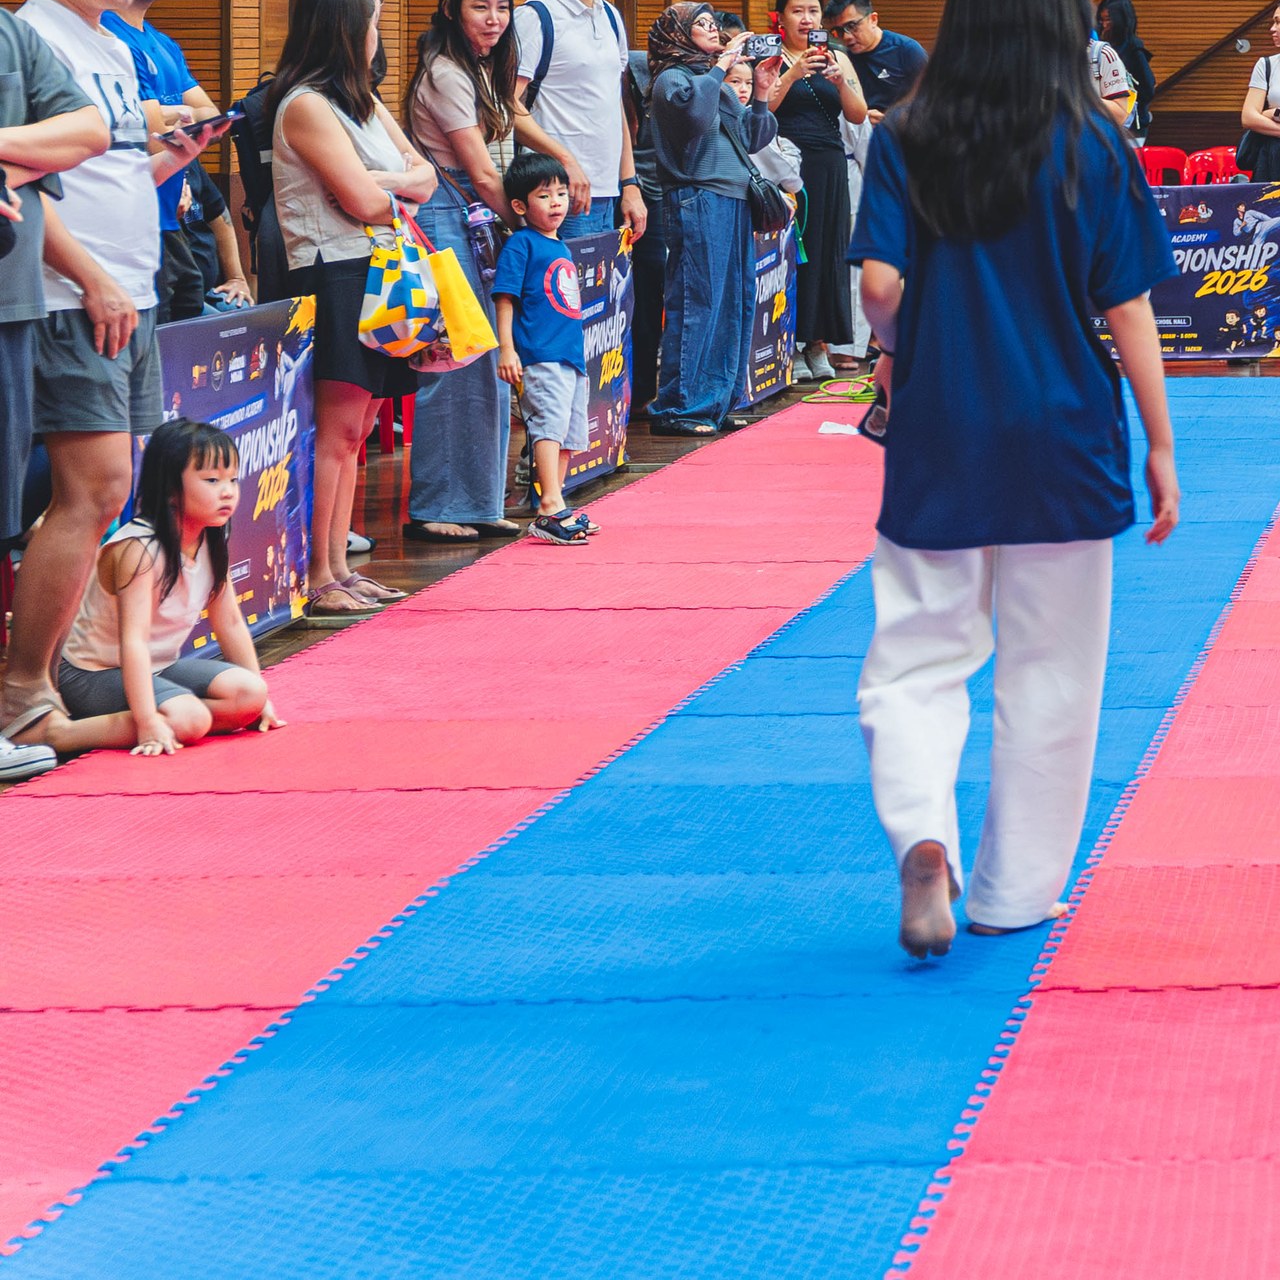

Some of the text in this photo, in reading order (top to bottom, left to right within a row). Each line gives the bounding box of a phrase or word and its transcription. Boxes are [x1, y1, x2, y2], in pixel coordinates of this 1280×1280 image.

[1171, 233, 1208, 243] ACADEMY
[1172, 241, 1279, 273] PIONSHIP
[1194, 265, 1271, 298] 2026
[584, 311, 627, 362] AMPIONSHIP
[598, 344, 625, 391] 2026
[235, 408, 298, 481] MPIONSHIP
[252, 451, 292, 521] 2026
